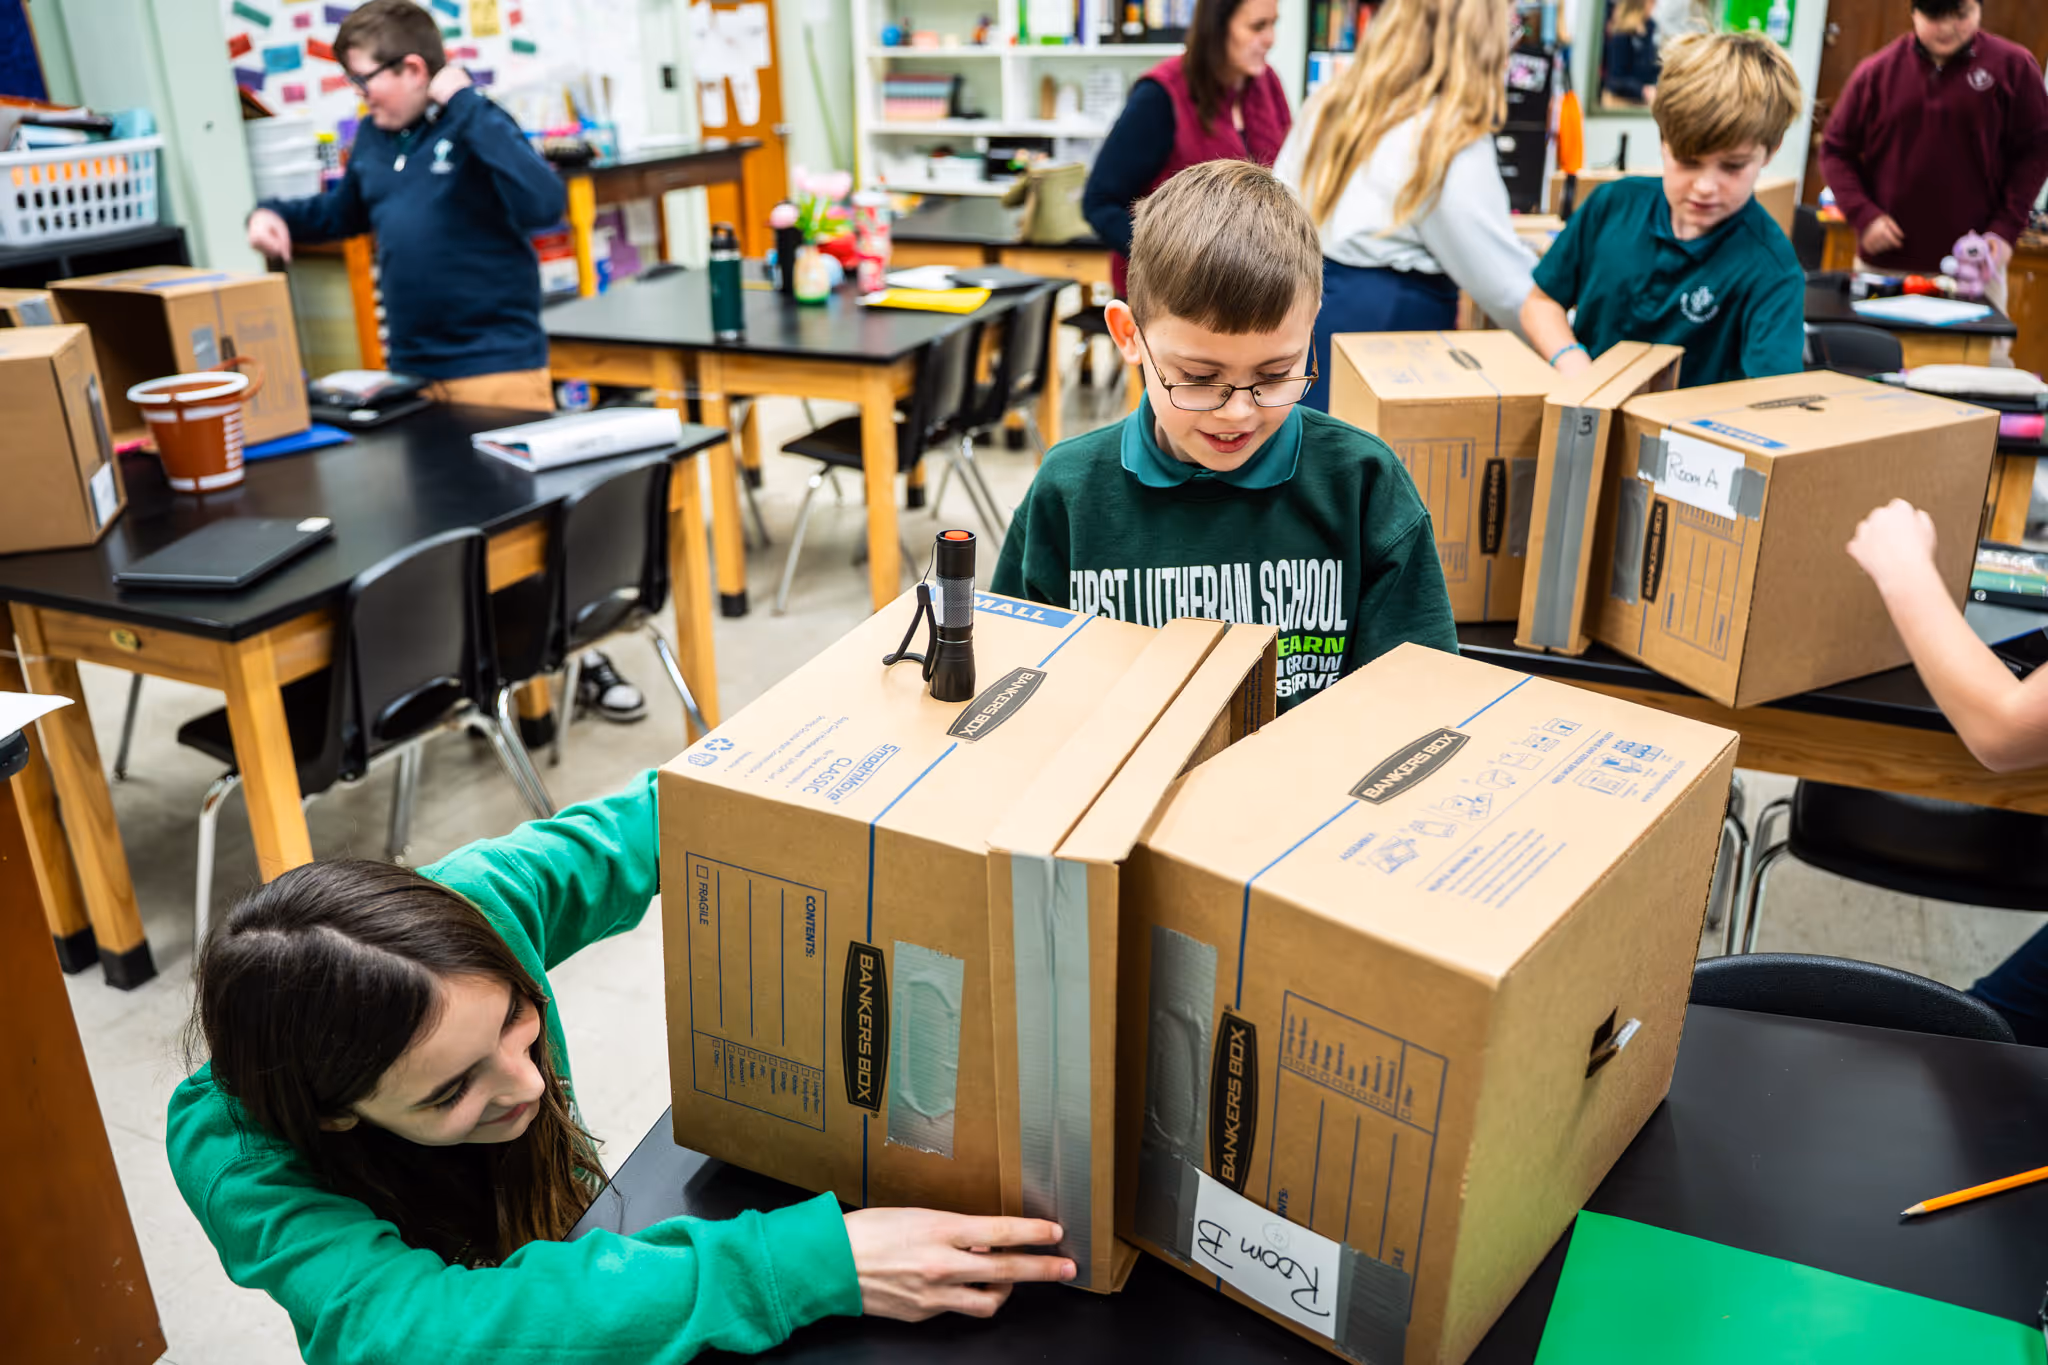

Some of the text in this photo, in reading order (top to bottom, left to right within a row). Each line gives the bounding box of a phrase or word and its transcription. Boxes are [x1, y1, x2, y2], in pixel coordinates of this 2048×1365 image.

[1578, 414, 1593, 437] 3
[1668, 451, 1718, 490] Room A
[974, 597, 1045, 621] MALL
[1259, 558, 1348, 633] SCHOOL
[1277, 635, 1346, 657] EARN
[959, 672, 1035, 737] BANKERS BOX
[1276, 671, 1340, 698] SRVE
[802, 757, 853, 795] CLASSIC
[1361, 733, 1459, 799] BANKERS BOX
[698, 882, 709, 926] FRAGILE
[805, 895, 817, 958] CONTENTS:
[857, 953, 874, 1102] BANKERS BOX
[1221, 1024, 1247, 1183] BANKERS BOX
[1239, 1236, 1331, 1317] Room
